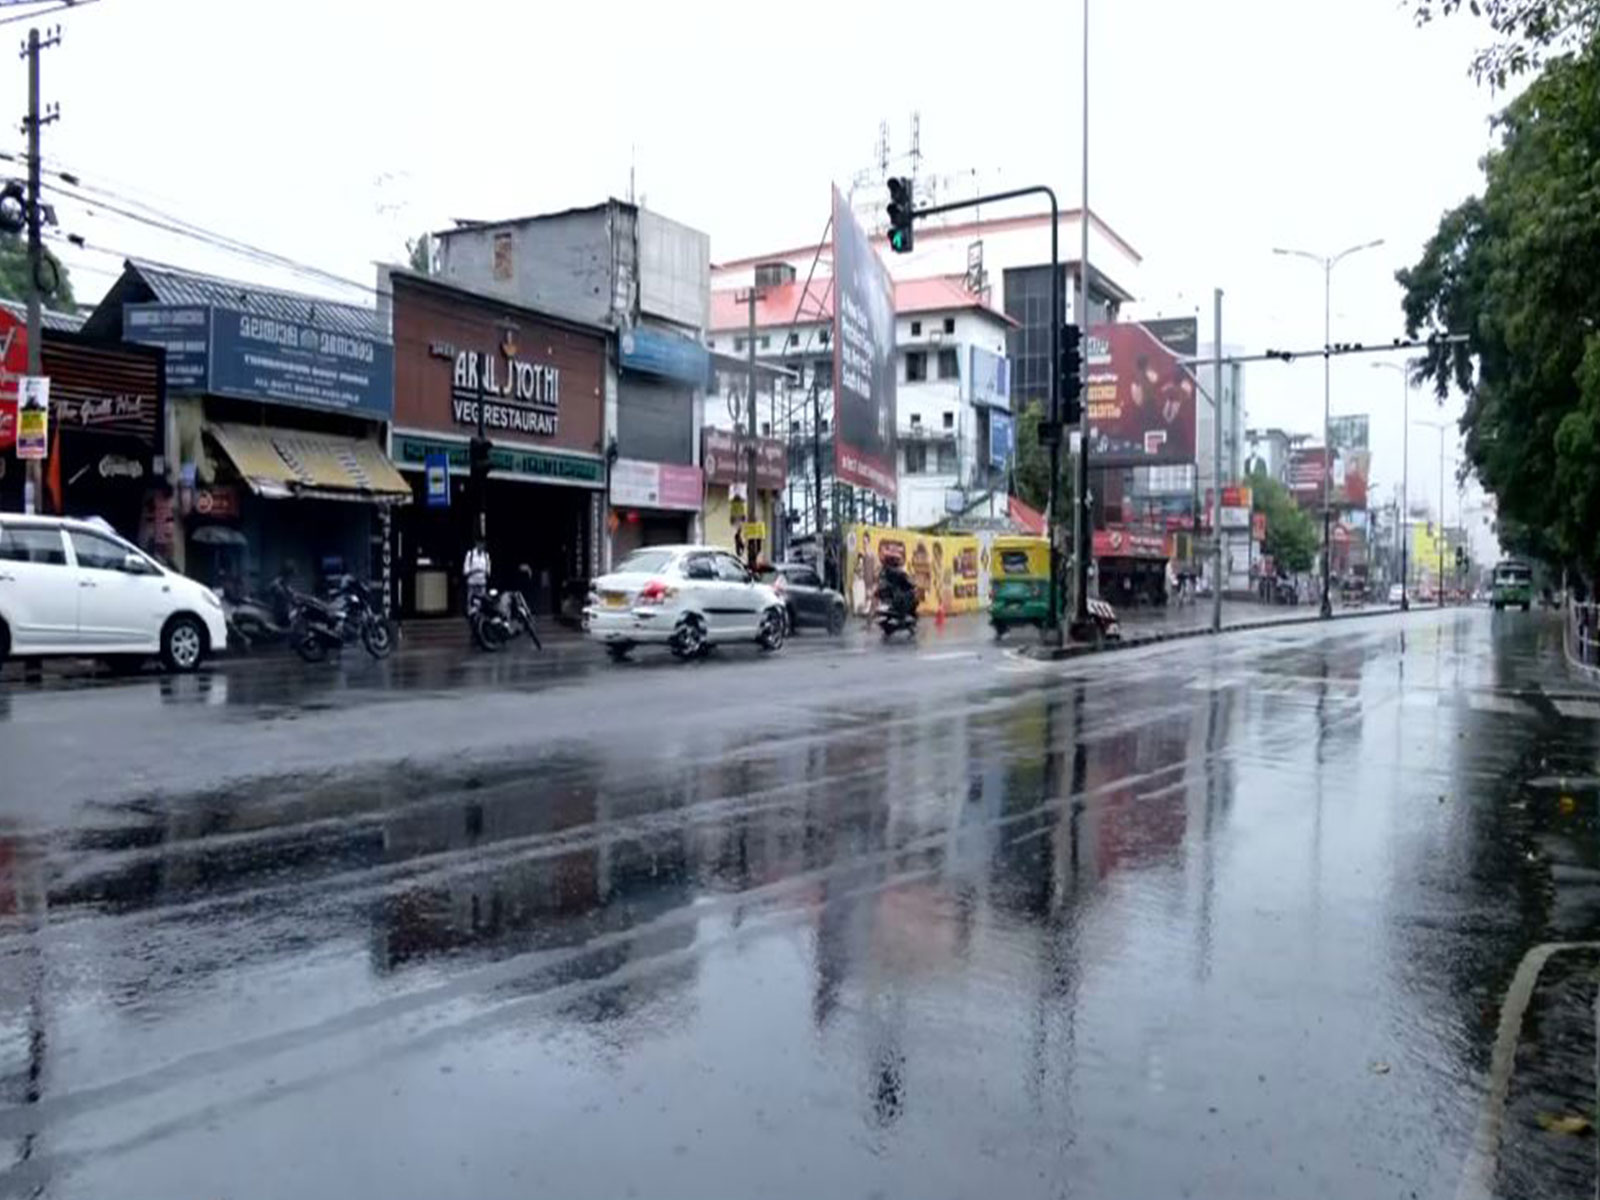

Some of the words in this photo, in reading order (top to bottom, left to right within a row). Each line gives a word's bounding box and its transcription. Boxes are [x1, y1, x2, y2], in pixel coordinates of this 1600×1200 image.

[503, 359, 559, 404] JYOTHI
[453, 400, 480, 422] VEG
[483, 403, 559, 434] RESTAURANT
